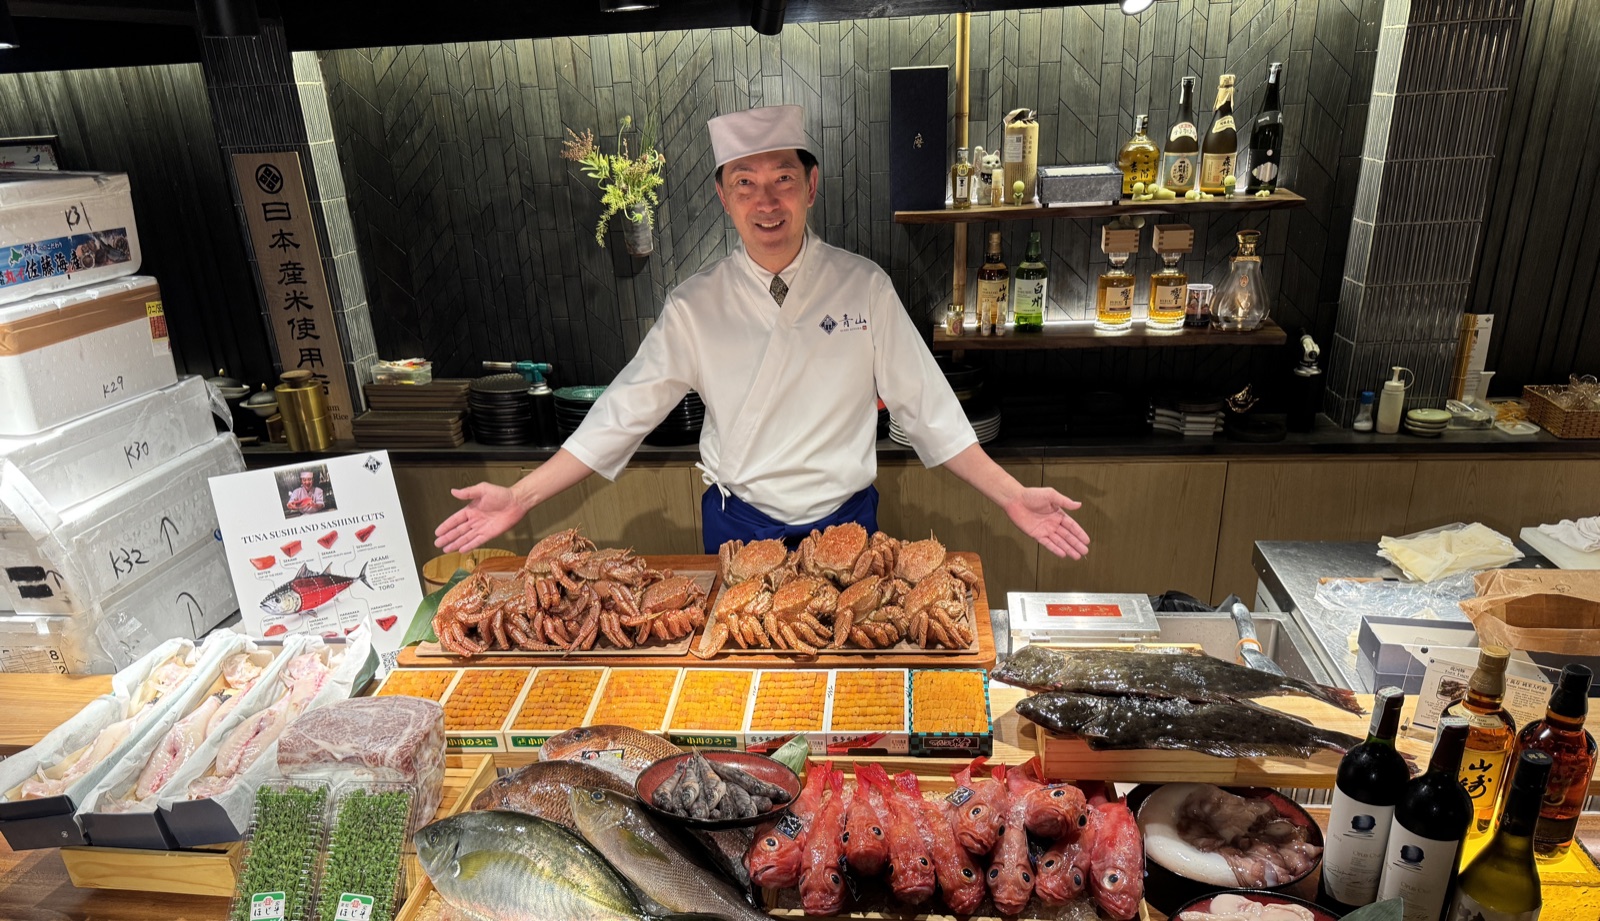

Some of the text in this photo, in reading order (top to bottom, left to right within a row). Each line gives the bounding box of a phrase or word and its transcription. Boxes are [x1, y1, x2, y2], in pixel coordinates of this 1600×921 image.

[839, 312, 867, 327] 青山
[103, 375, 124, 399] K29
[124, 441, 150, 469] K30
[241, 511, 385, 545] TUNA SUSHI AND SASHIMI CUTS
[109, 547, 150, 579] K32
[370, 555, 389, 563] AKAMI
[49, 650, 60, 660] 8
